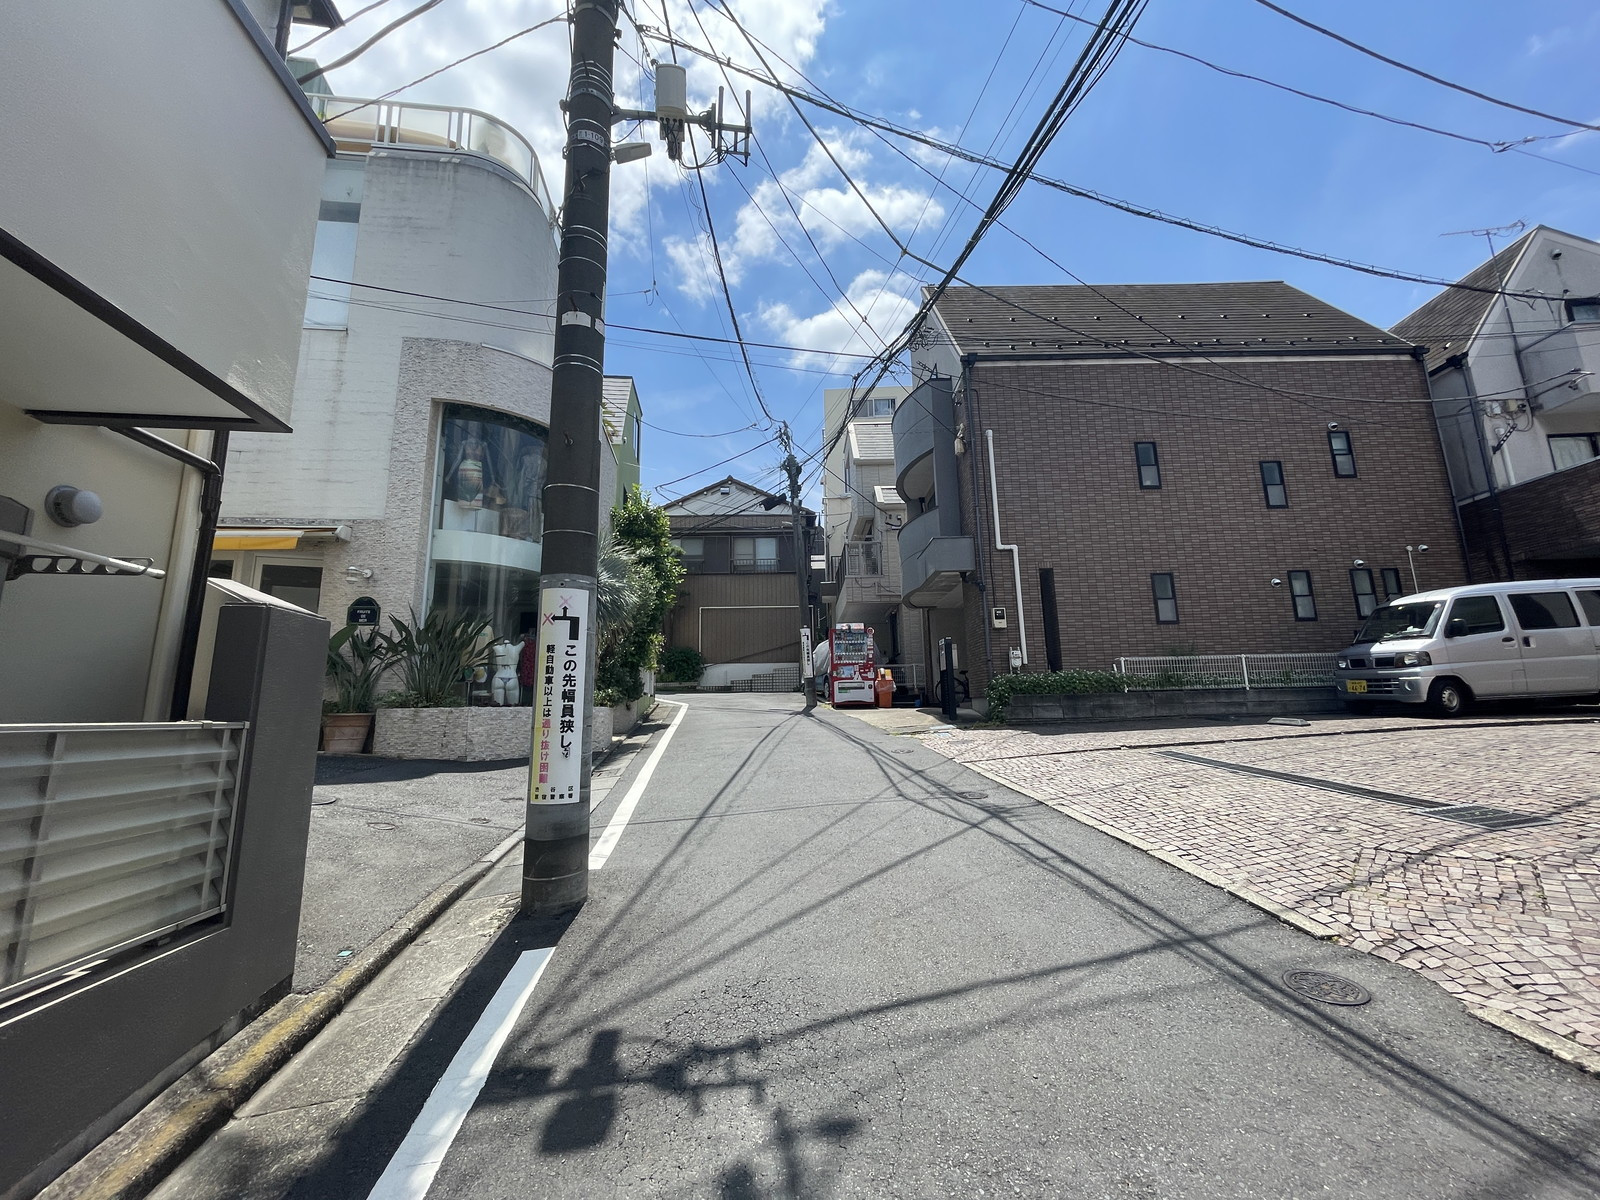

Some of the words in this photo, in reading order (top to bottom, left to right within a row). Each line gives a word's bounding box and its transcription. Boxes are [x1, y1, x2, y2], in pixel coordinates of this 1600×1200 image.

[560, 644, 577, 748] この先幅員狭し
